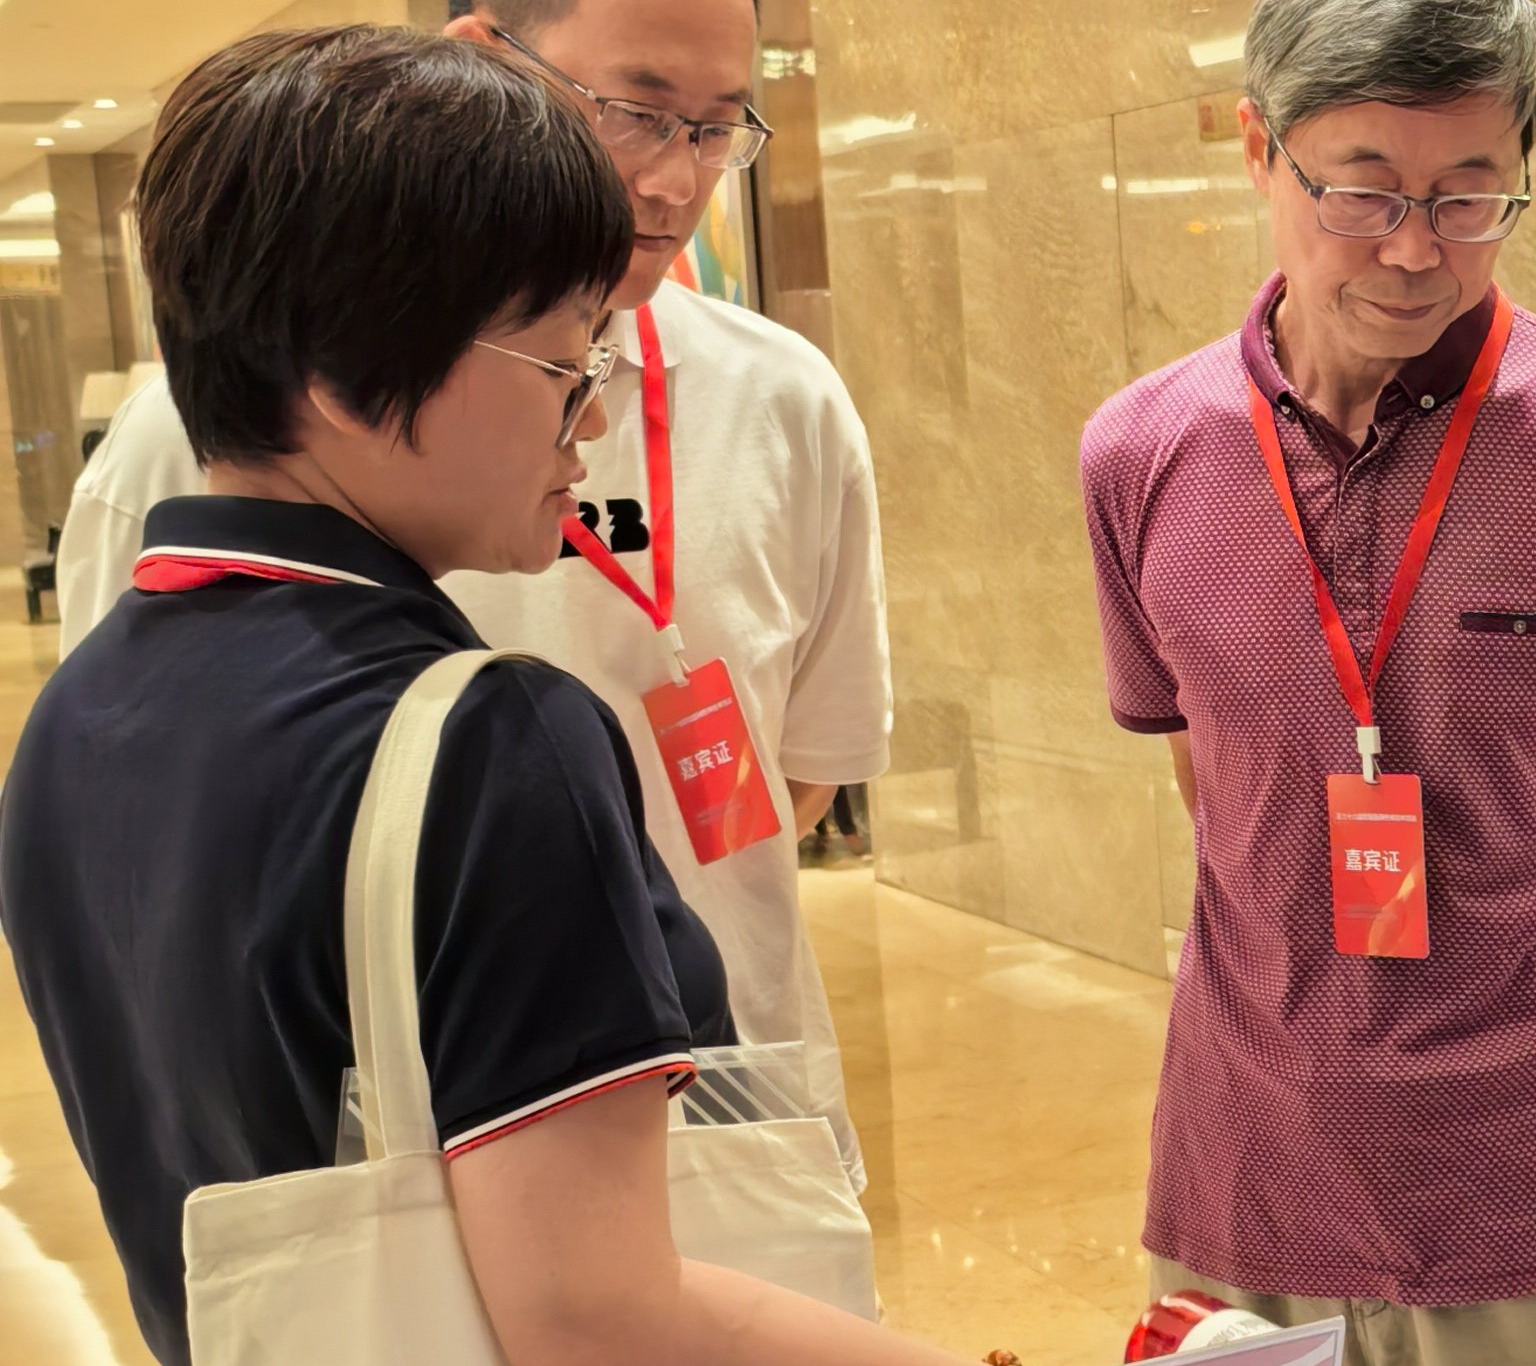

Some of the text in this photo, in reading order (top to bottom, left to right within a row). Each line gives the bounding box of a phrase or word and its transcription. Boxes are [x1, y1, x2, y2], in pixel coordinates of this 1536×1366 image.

[676, 739, 733, 782] 嘉宾证
[1344, 848, 1401, 873] 嘉宾证
